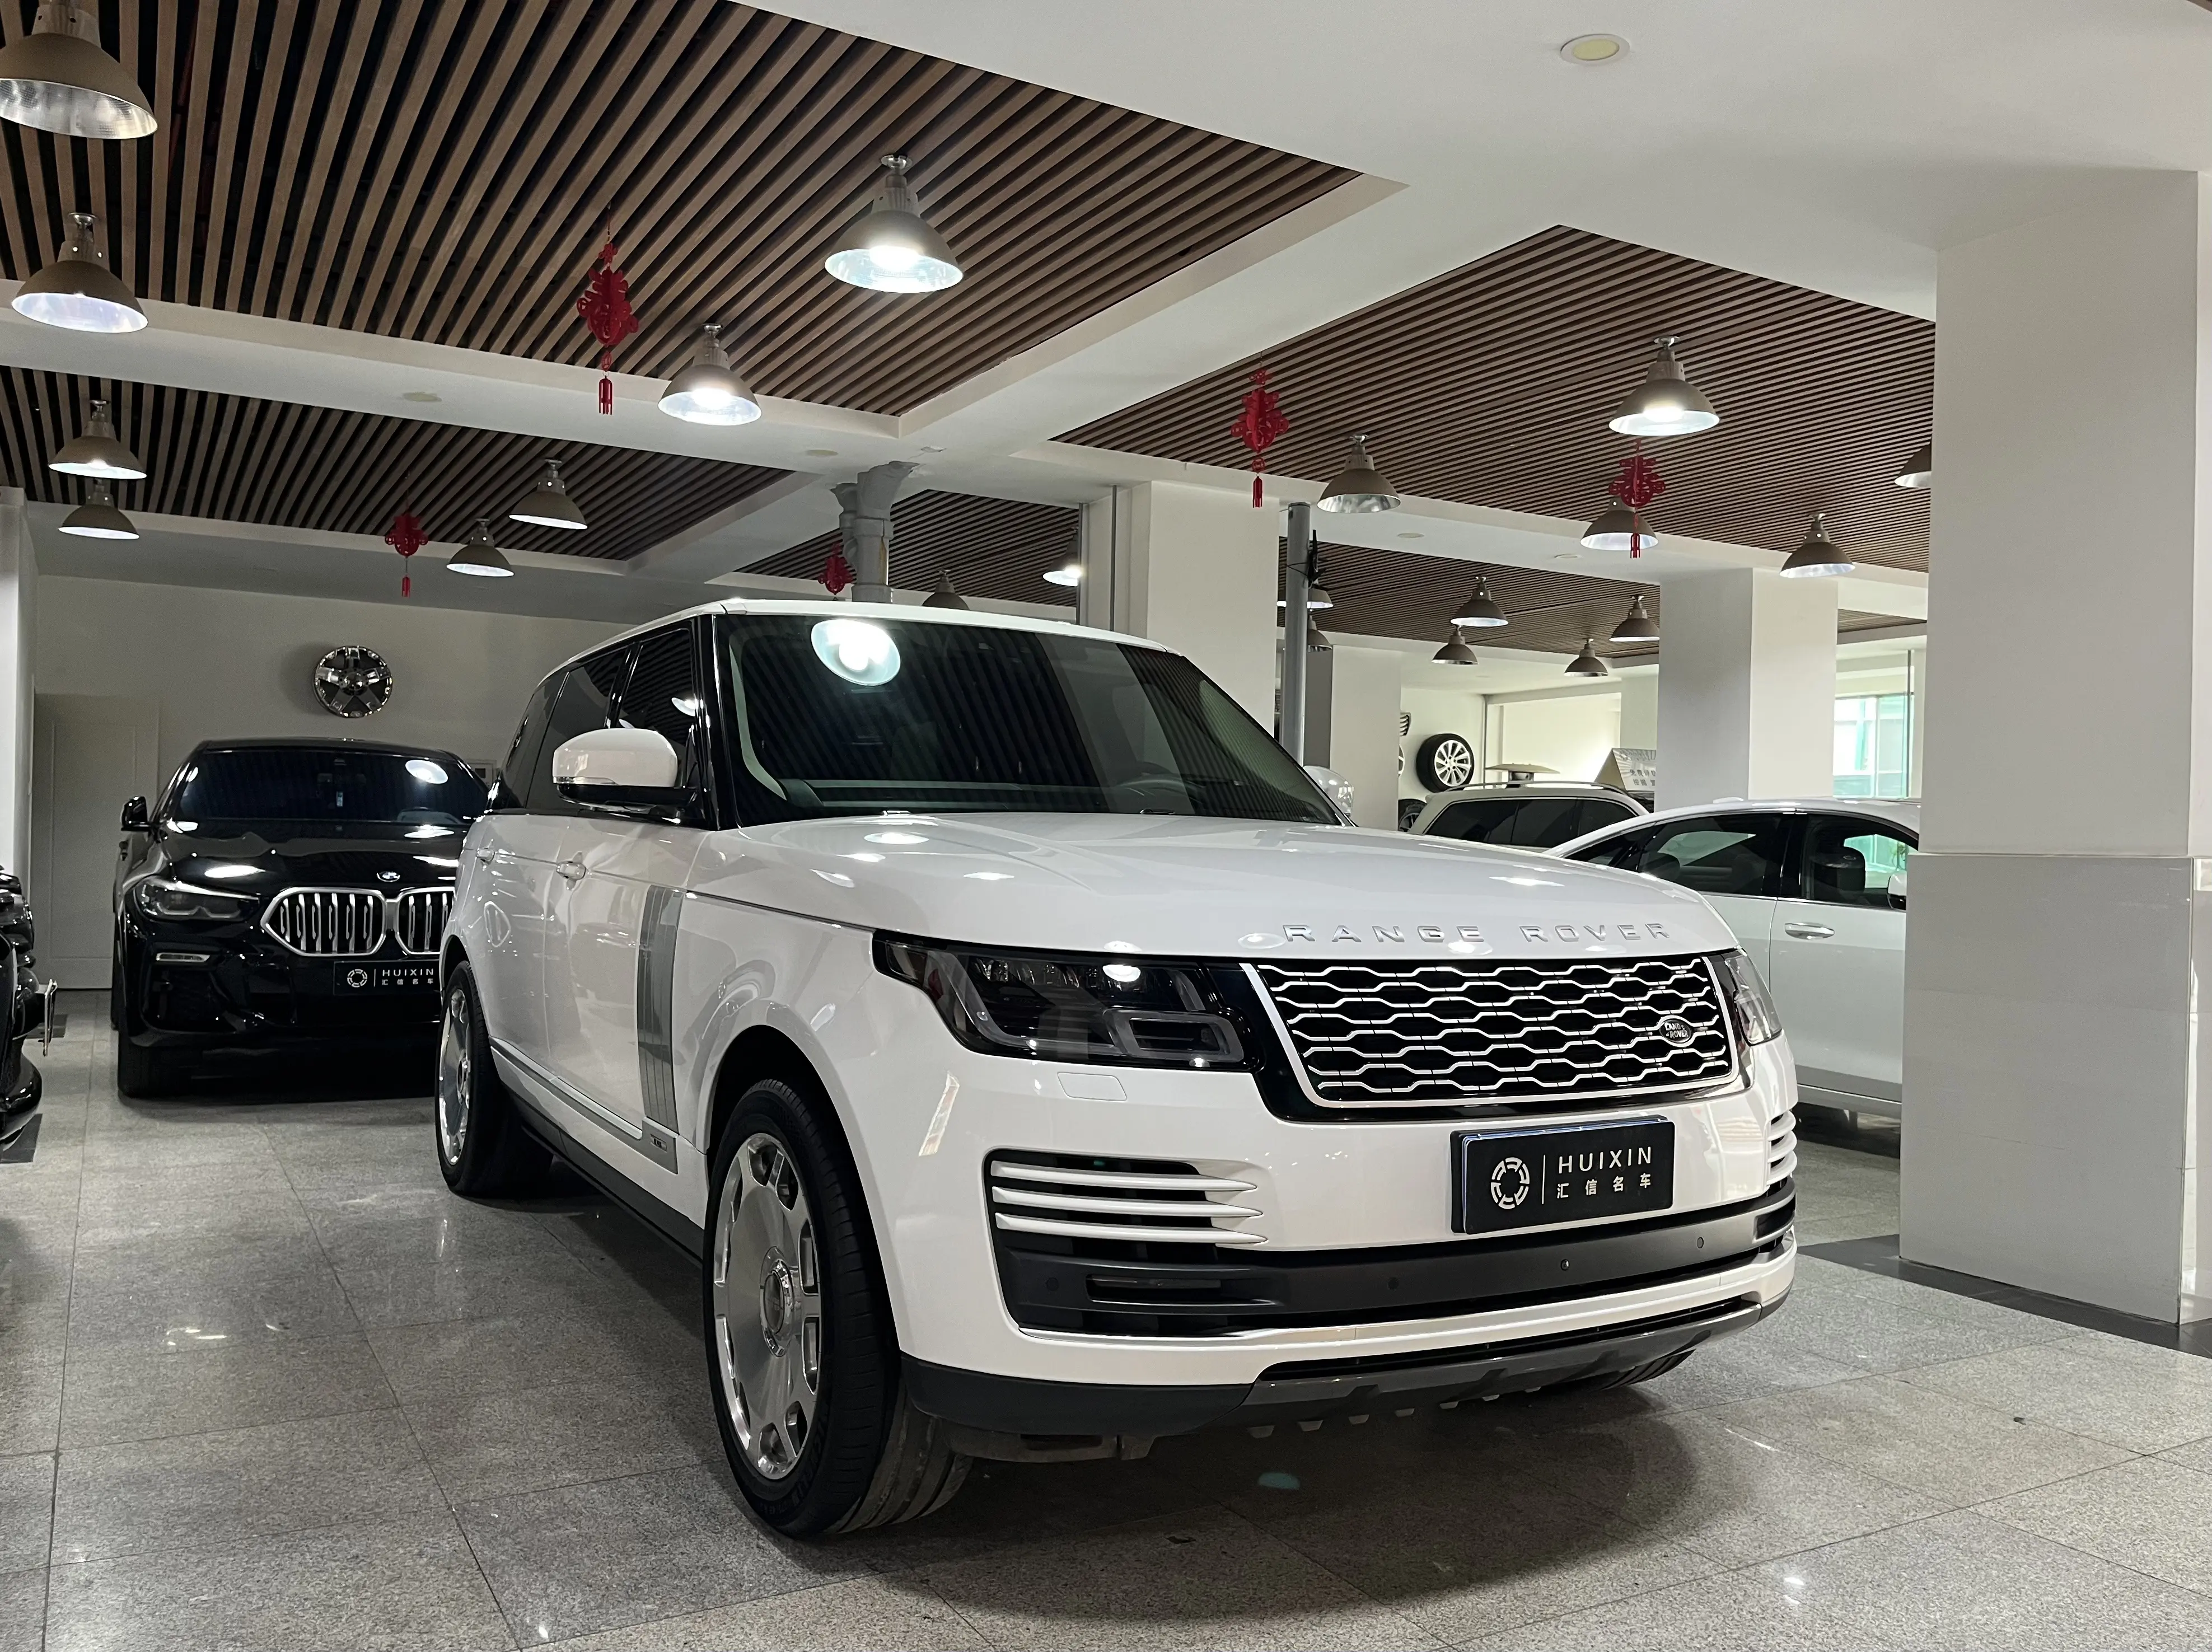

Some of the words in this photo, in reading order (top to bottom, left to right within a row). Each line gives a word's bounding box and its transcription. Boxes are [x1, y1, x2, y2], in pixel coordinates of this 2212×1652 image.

[1282, 924, 1484, 943] RANGE
[1519, 923, 1670, 942] ROVER
[382, 968, 434, 977] HUIXIN
[1559, 1146, 1652, 1174] HUIXIN
[1556, 1172, 1652, 1199] 汇信名车
